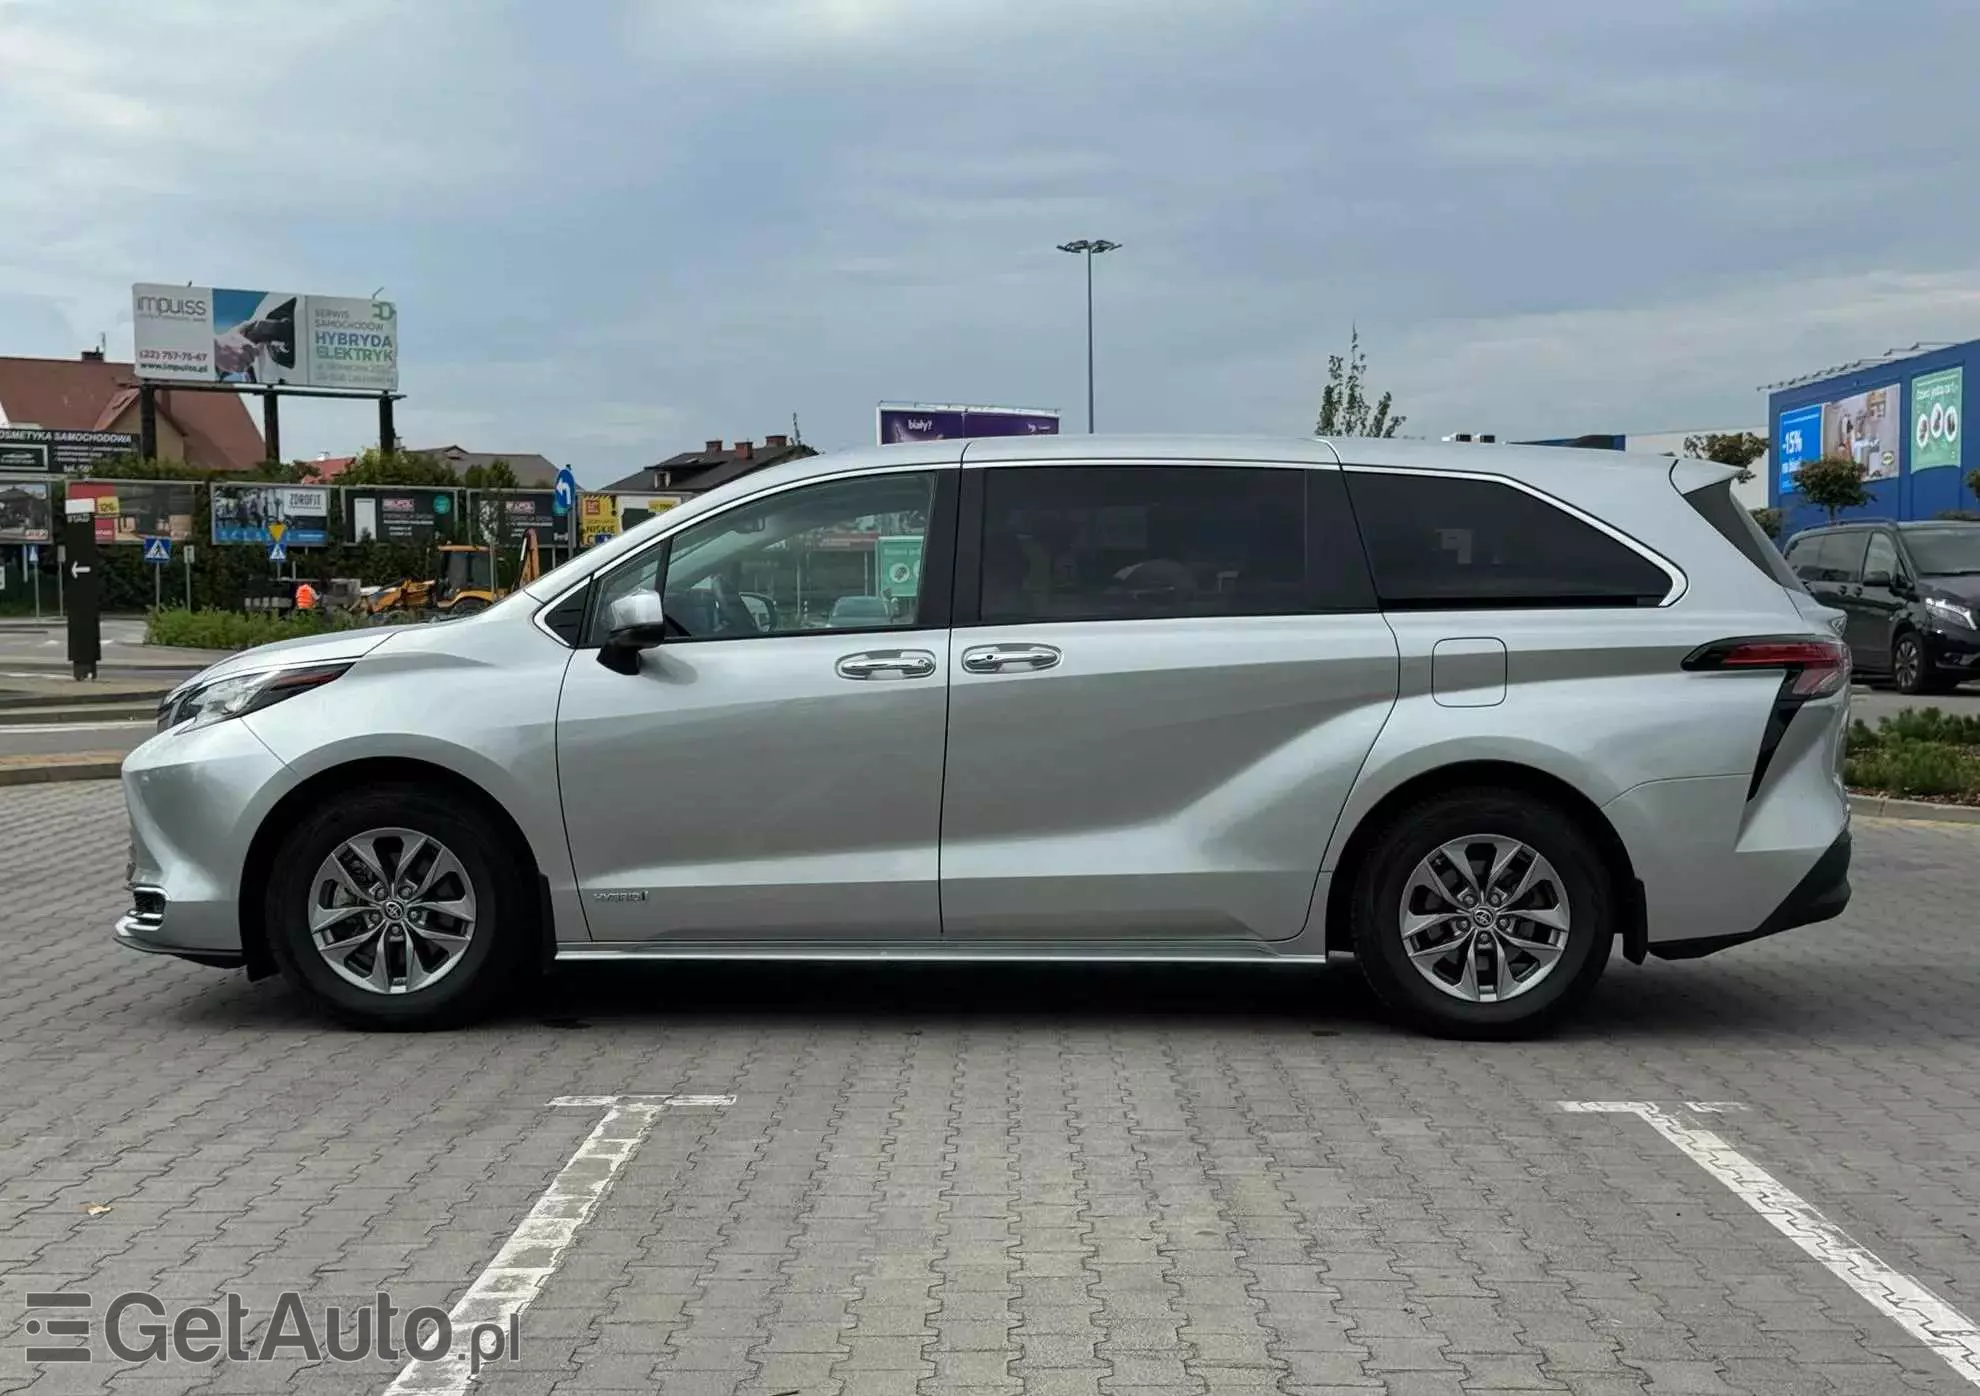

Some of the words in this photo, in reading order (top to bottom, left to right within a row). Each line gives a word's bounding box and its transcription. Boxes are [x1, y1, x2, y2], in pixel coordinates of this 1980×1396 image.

[315, 330, 393, 348] HYBRYDA
[316, 345, 394, 361] ELEKTRYK
[54, 433, 132, 443] SAMOCHODOWA
